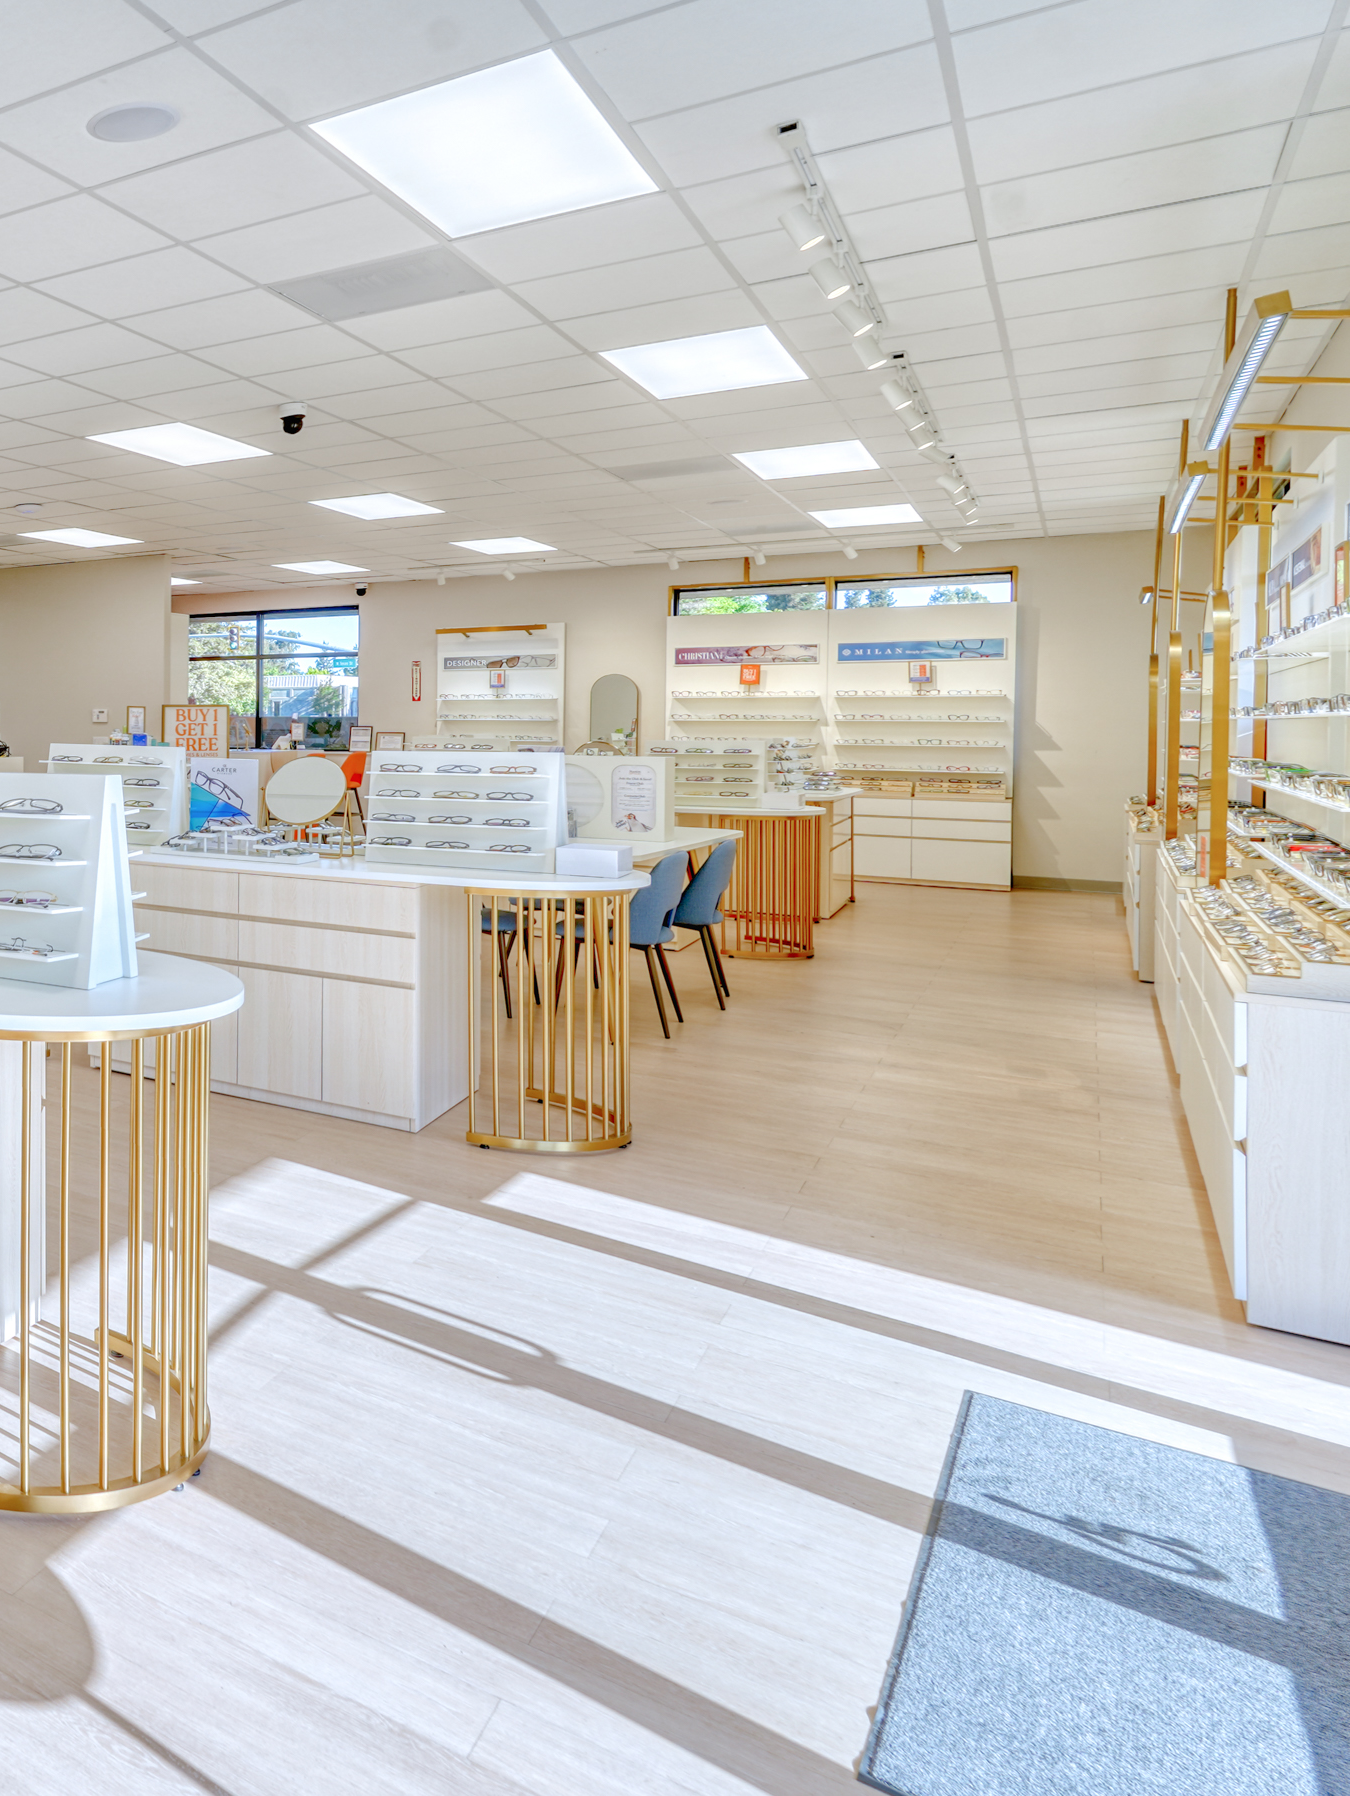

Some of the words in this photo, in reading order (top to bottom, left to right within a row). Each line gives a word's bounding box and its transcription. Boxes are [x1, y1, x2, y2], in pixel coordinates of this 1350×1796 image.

[678, 652, 719, 661] CHRISTIAN
[854, 648, 903, 656] MILAN
[446, 659, 487, 667] DESIGNER
[175, 708, 210, 722] BUY
[213, 708, 218, 722] 1
[175, 723, 208, 736] GET
[213, 723, 218, 736] 1
[175, 737, 219, 751] FREE
